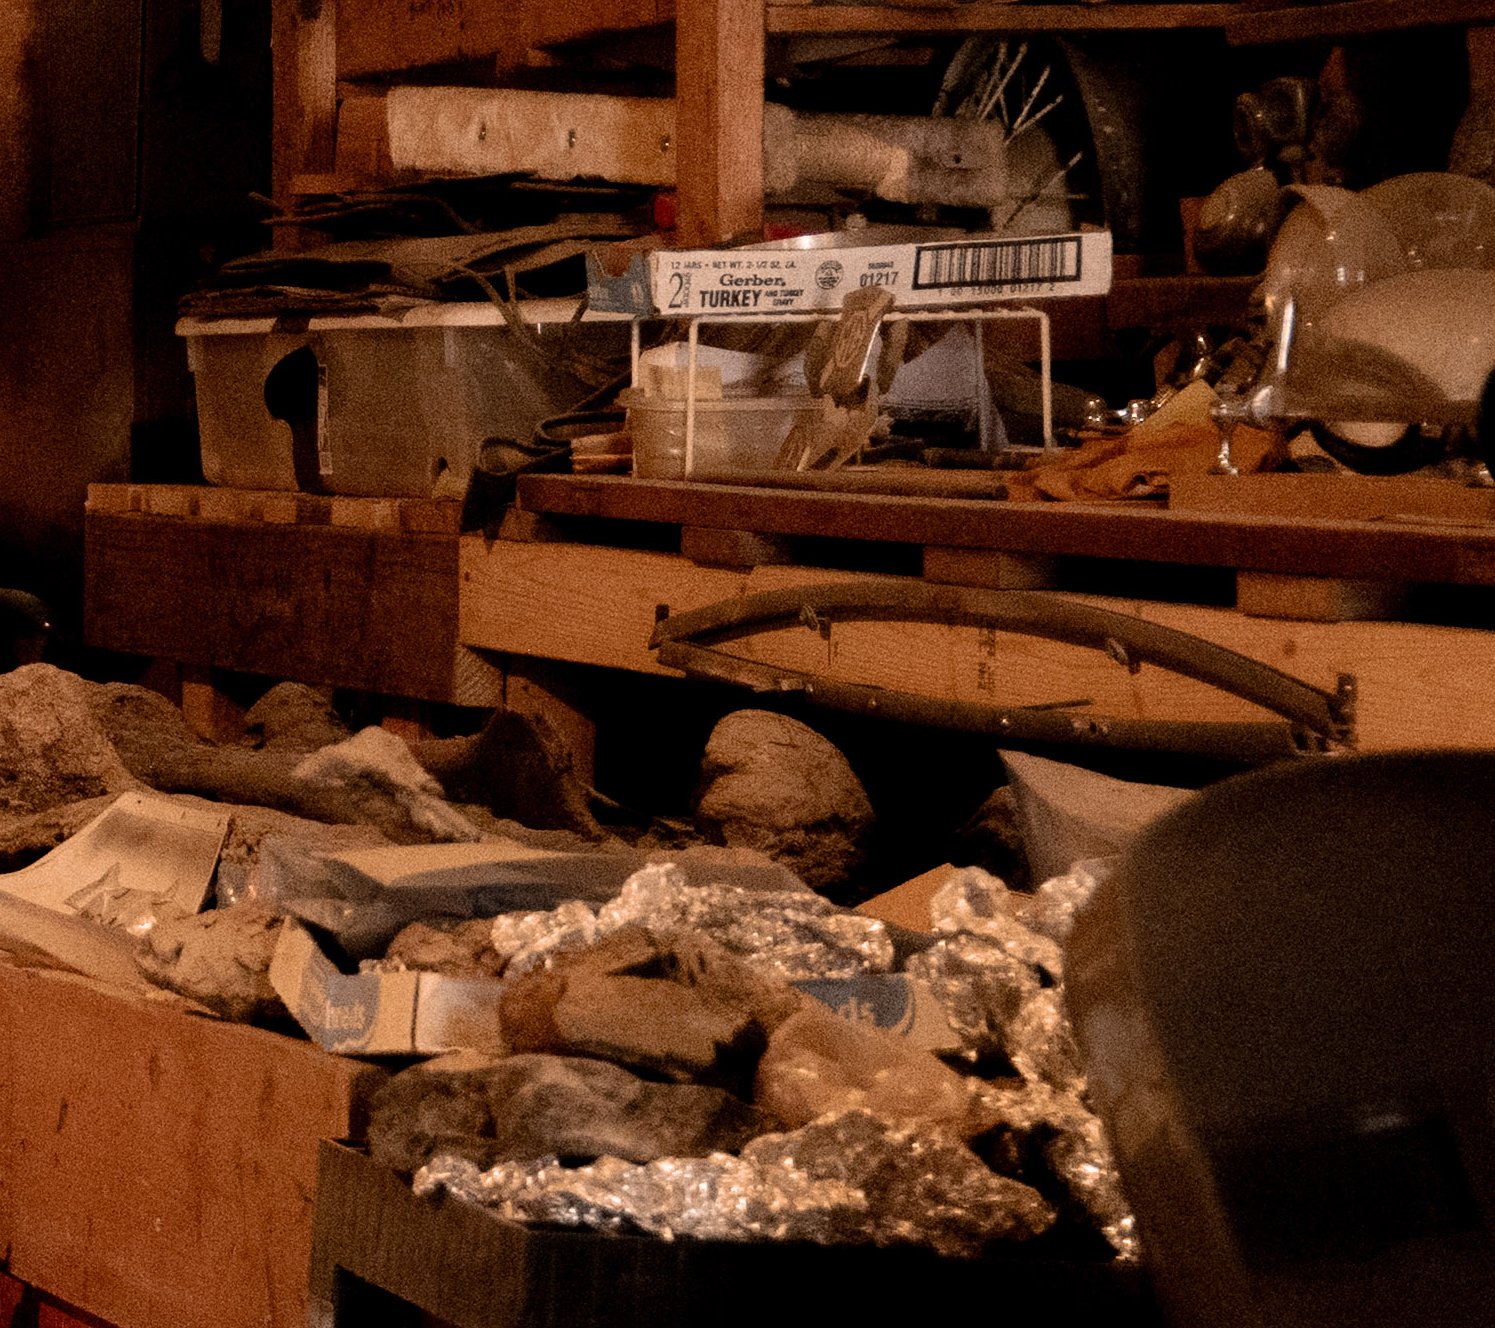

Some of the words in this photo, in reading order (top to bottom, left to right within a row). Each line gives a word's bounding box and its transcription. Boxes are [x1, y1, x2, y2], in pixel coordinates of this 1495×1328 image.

[671, 261, 681, 270] 12
[712, 261, 727, 270] NET
[860, 271, 899, 288] 01217
[1010, 283, 1042, 293] 01217
[700, 289, 762, 308] TURKEY
